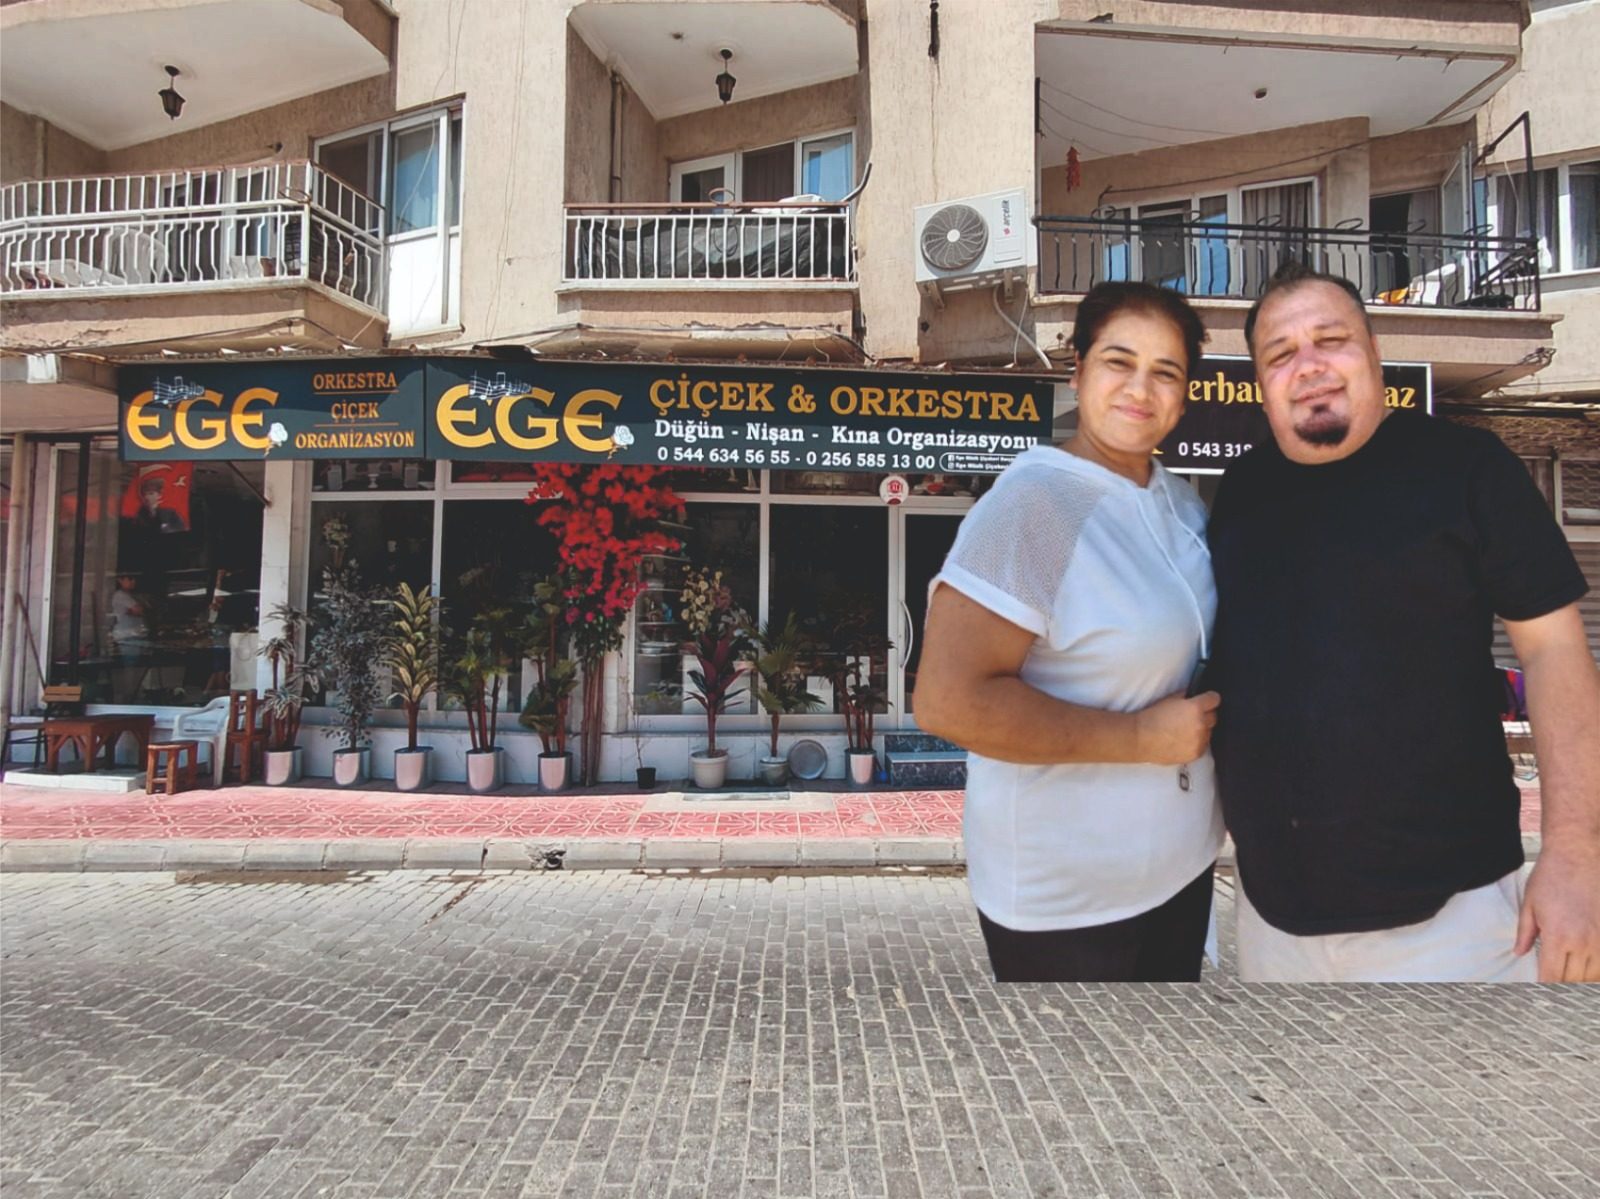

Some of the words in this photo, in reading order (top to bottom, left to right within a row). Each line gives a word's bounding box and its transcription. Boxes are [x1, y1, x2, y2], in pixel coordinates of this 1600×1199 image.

[313, 372, 397, 390] ORKESTRA
[649, 373, 775, 417] ÇİÇEK
[788, 384, 816, 413] &
[830, 386, 1040, 422] ORKESTRA
[126, 387, 279, 450] EGE
[331, 402, 379, 423] ÇİÇEK
[436, 384, 622, 452] EGE
[295, 430, 415, 449] ORGANİZASYON
[654, 419, 724, 443] Düğün
[746, 422, 805, 445] Nişan
[831, 426, 880, 445] Kına
[887, 427, 1038, 452] Organizasyonu
[657, 446, 668, 461] 0
[673, 447, 704, 462] 544
[709, 448, 740, 463] 634
[745, 449, 765, 464] 56
[770, 450, 790, 465] 55
[806, 451, 817, 466] 0
[821, 452, 852, 467] 256
[857, 453, 886, 468] 585
[892, 454, 910, 469] 13
[915, 455, 935, 469] 00
[1178, 442, 1189, 456] 0
[1192, 442, 1221, 457] 543
